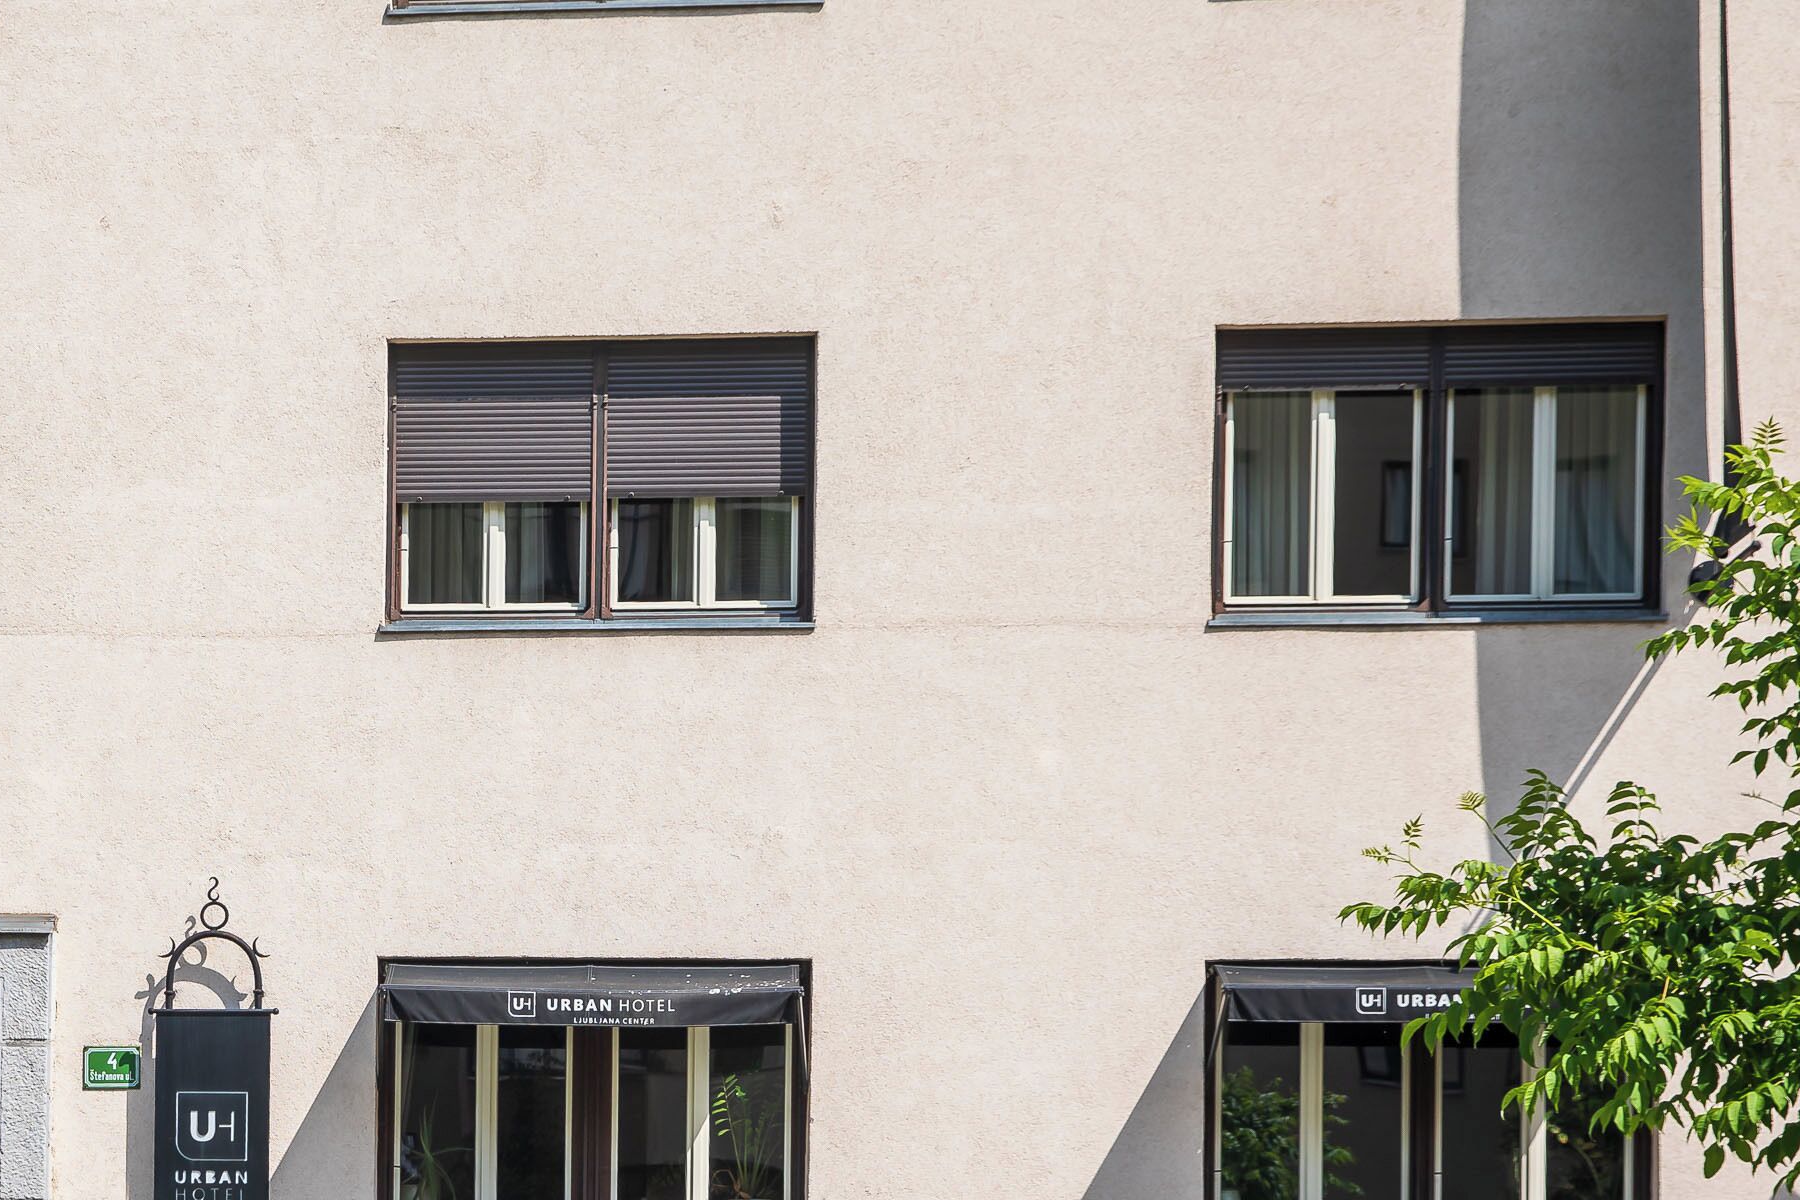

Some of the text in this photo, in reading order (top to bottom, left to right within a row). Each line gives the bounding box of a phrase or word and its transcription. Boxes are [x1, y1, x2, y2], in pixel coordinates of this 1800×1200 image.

[546, 998, 676, 1013] URBAN HOTEL
[573, 1016, 655, 1025] LJUBLJANA CENTER
[106, 1052, 118, 1070] 4
[89, 1068, 124, 1081] Štefanova
[189, 1110, 235, 1142] UH
[174, 1170, 248, 1185] URBAN
